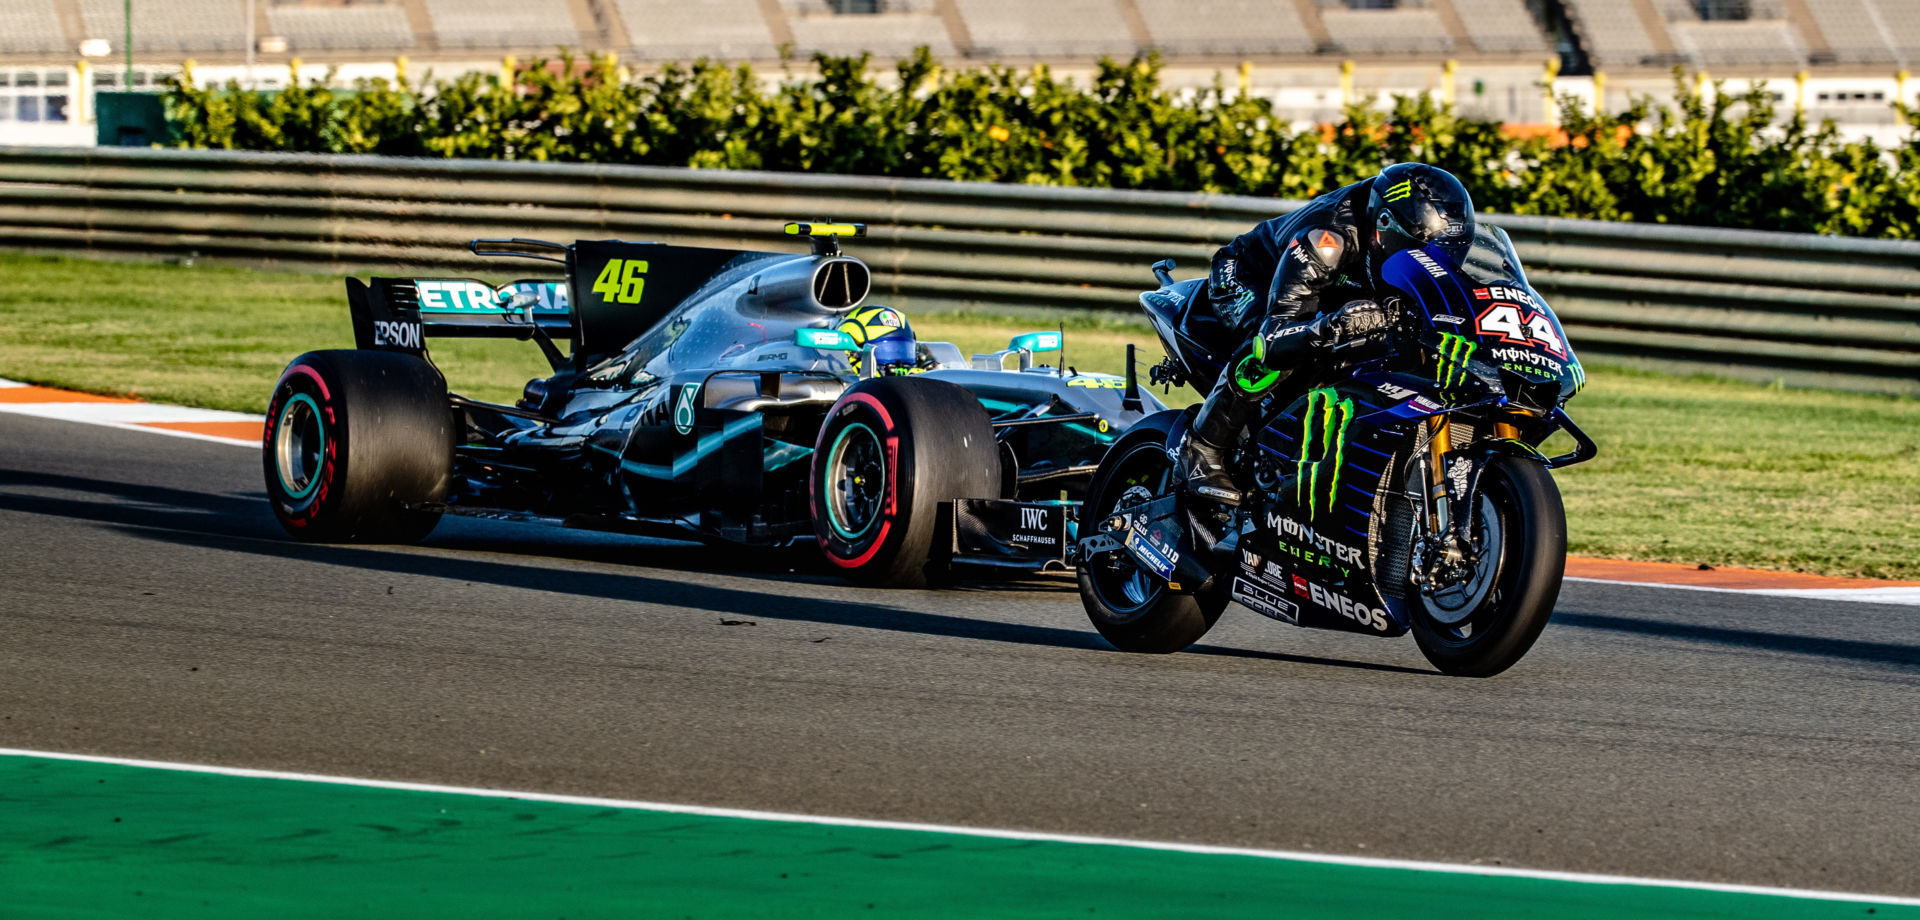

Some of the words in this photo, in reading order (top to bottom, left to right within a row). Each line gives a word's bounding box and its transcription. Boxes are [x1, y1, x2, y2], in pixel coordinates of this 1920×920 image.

[1407, 249, 1448, 278] YAMAHA
[592, 258, 649, 304] 46
[1489, 286, 1546, 315] ENEOS
[374, 320, 420, 348] EPSON
[1478, 304, 1565, 357] 44
[1491, 347, 1564, 376] MONSTER
[1503, 362, 1557, 381] ENERGY
[1020, 507, 1048, 531] IWC
[1012, 533, 1056, 545] SCHAFFHAUSEN
[1162, 542, 1179, 563] DID
[1278, 540, 1349, 578] ENERY
[1243, 583, 1289, 612] BLUE
[1309, 582, 1388, 631] ENEOS
